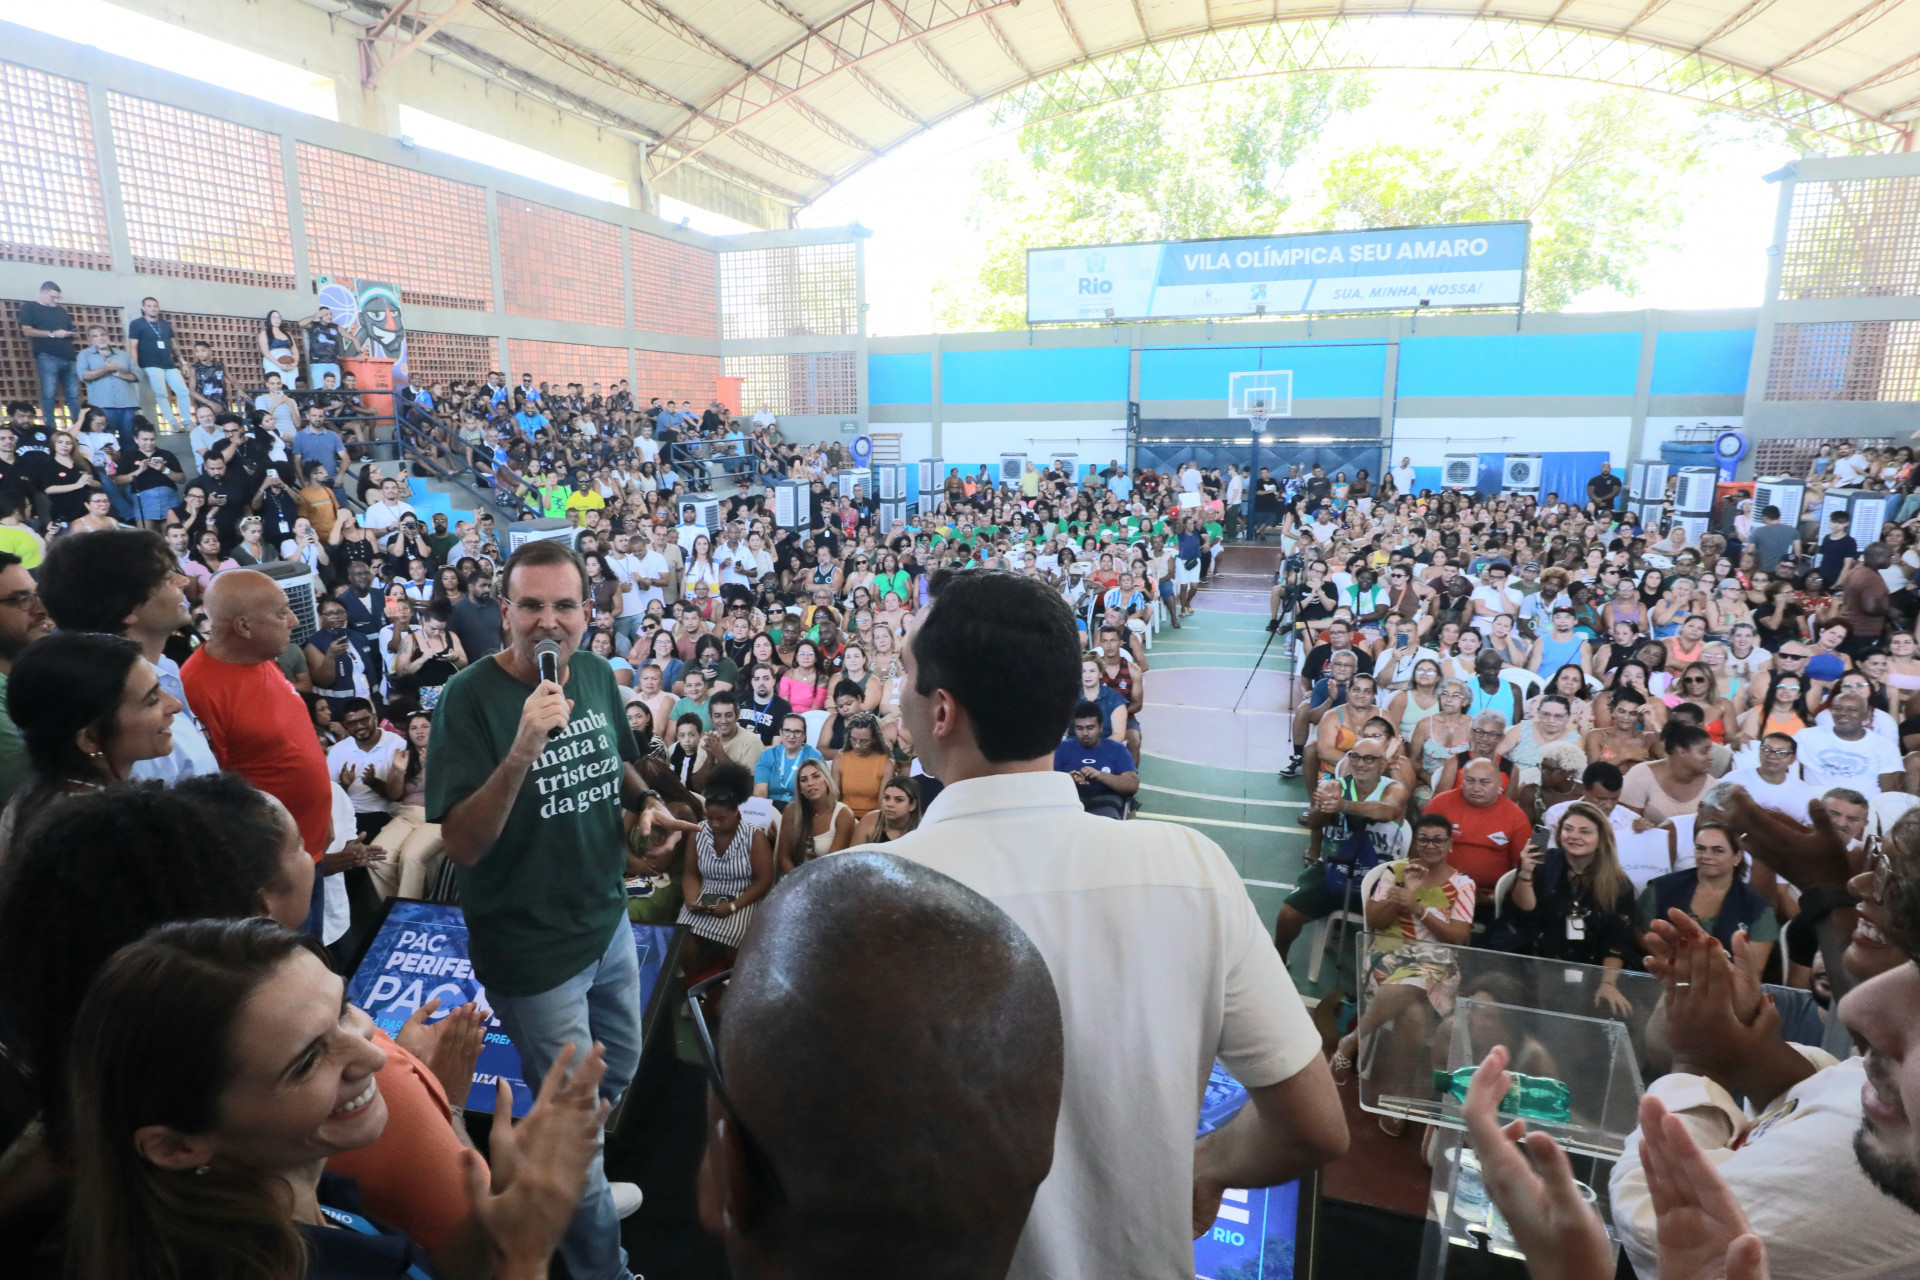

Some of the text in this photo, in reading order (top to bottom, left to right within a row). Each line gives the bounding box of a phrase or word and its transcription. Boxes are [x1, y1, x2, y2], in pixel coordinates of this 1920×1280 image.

[1184, 238, 1489, 271] VILA OLÍMPICA SEU AMARO
[1078, 277, 1113, 295] Rio
[1333, 281, 1483, 300] SUA, MINHA, NOSSA!
[549, 709, 608, 742] amba
[531, 734, 609, 771] mata a
[535, 756, 619, 795] tristeza
[540, 794, 575, 819] da
[395, 930, 448, 953] PAC
[362, 974, 462, 1019] PAC
[484, 1033, 511, 1045] PRE
[1213, 1226, 1246, 1247] RIO
